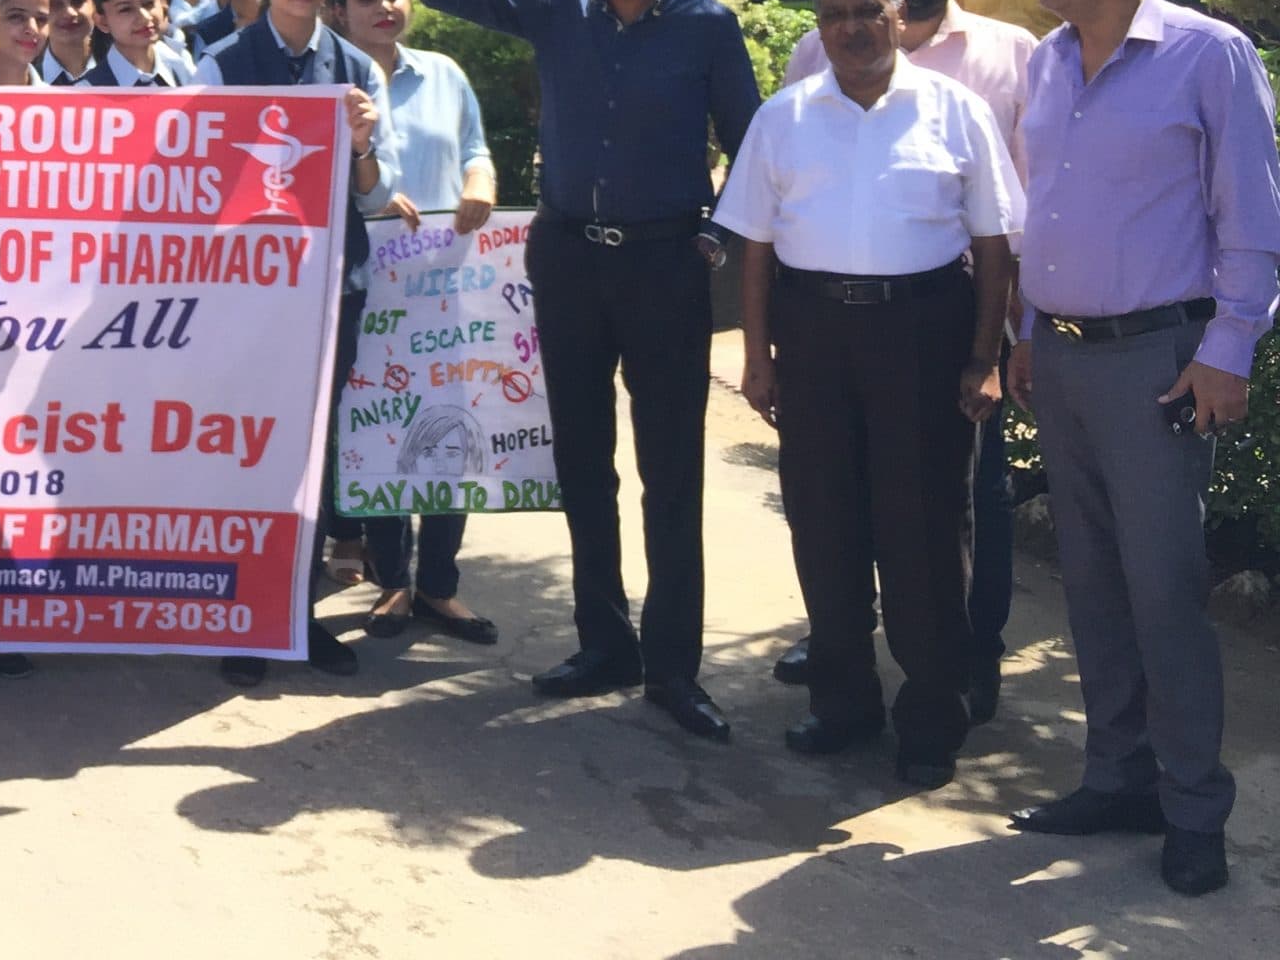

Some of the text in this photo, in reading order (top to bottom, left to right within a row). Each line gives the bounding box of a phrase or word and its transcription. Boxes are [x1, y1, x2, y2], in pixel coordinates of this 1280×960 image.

[155, 109, 226, 158] OF
[373, 228, 454, 271] PRESSED
[478, 225, 532, 254] ADDIC
[70, 232, 310, 287] PHARMACY
[404, 265, 496, 298] WIERD
[82, 297, 199, 350] All
[364, 310, 407, 335] OST
[410, 321, 495, 354] ESCAPE
[429, 359, 511, 387] EMPTY
[350, 394, 422, 432] ANGRY
[151, 400, 276, 468] Day
[491, 424, 552, 454] HOPEL
[348, 480, 407, 511] SAY
[412, 480, 453, 512] NO
[40, 513, 273, 555] PHARMACY
[75, 566, 229, 593] M.Pharmacy
